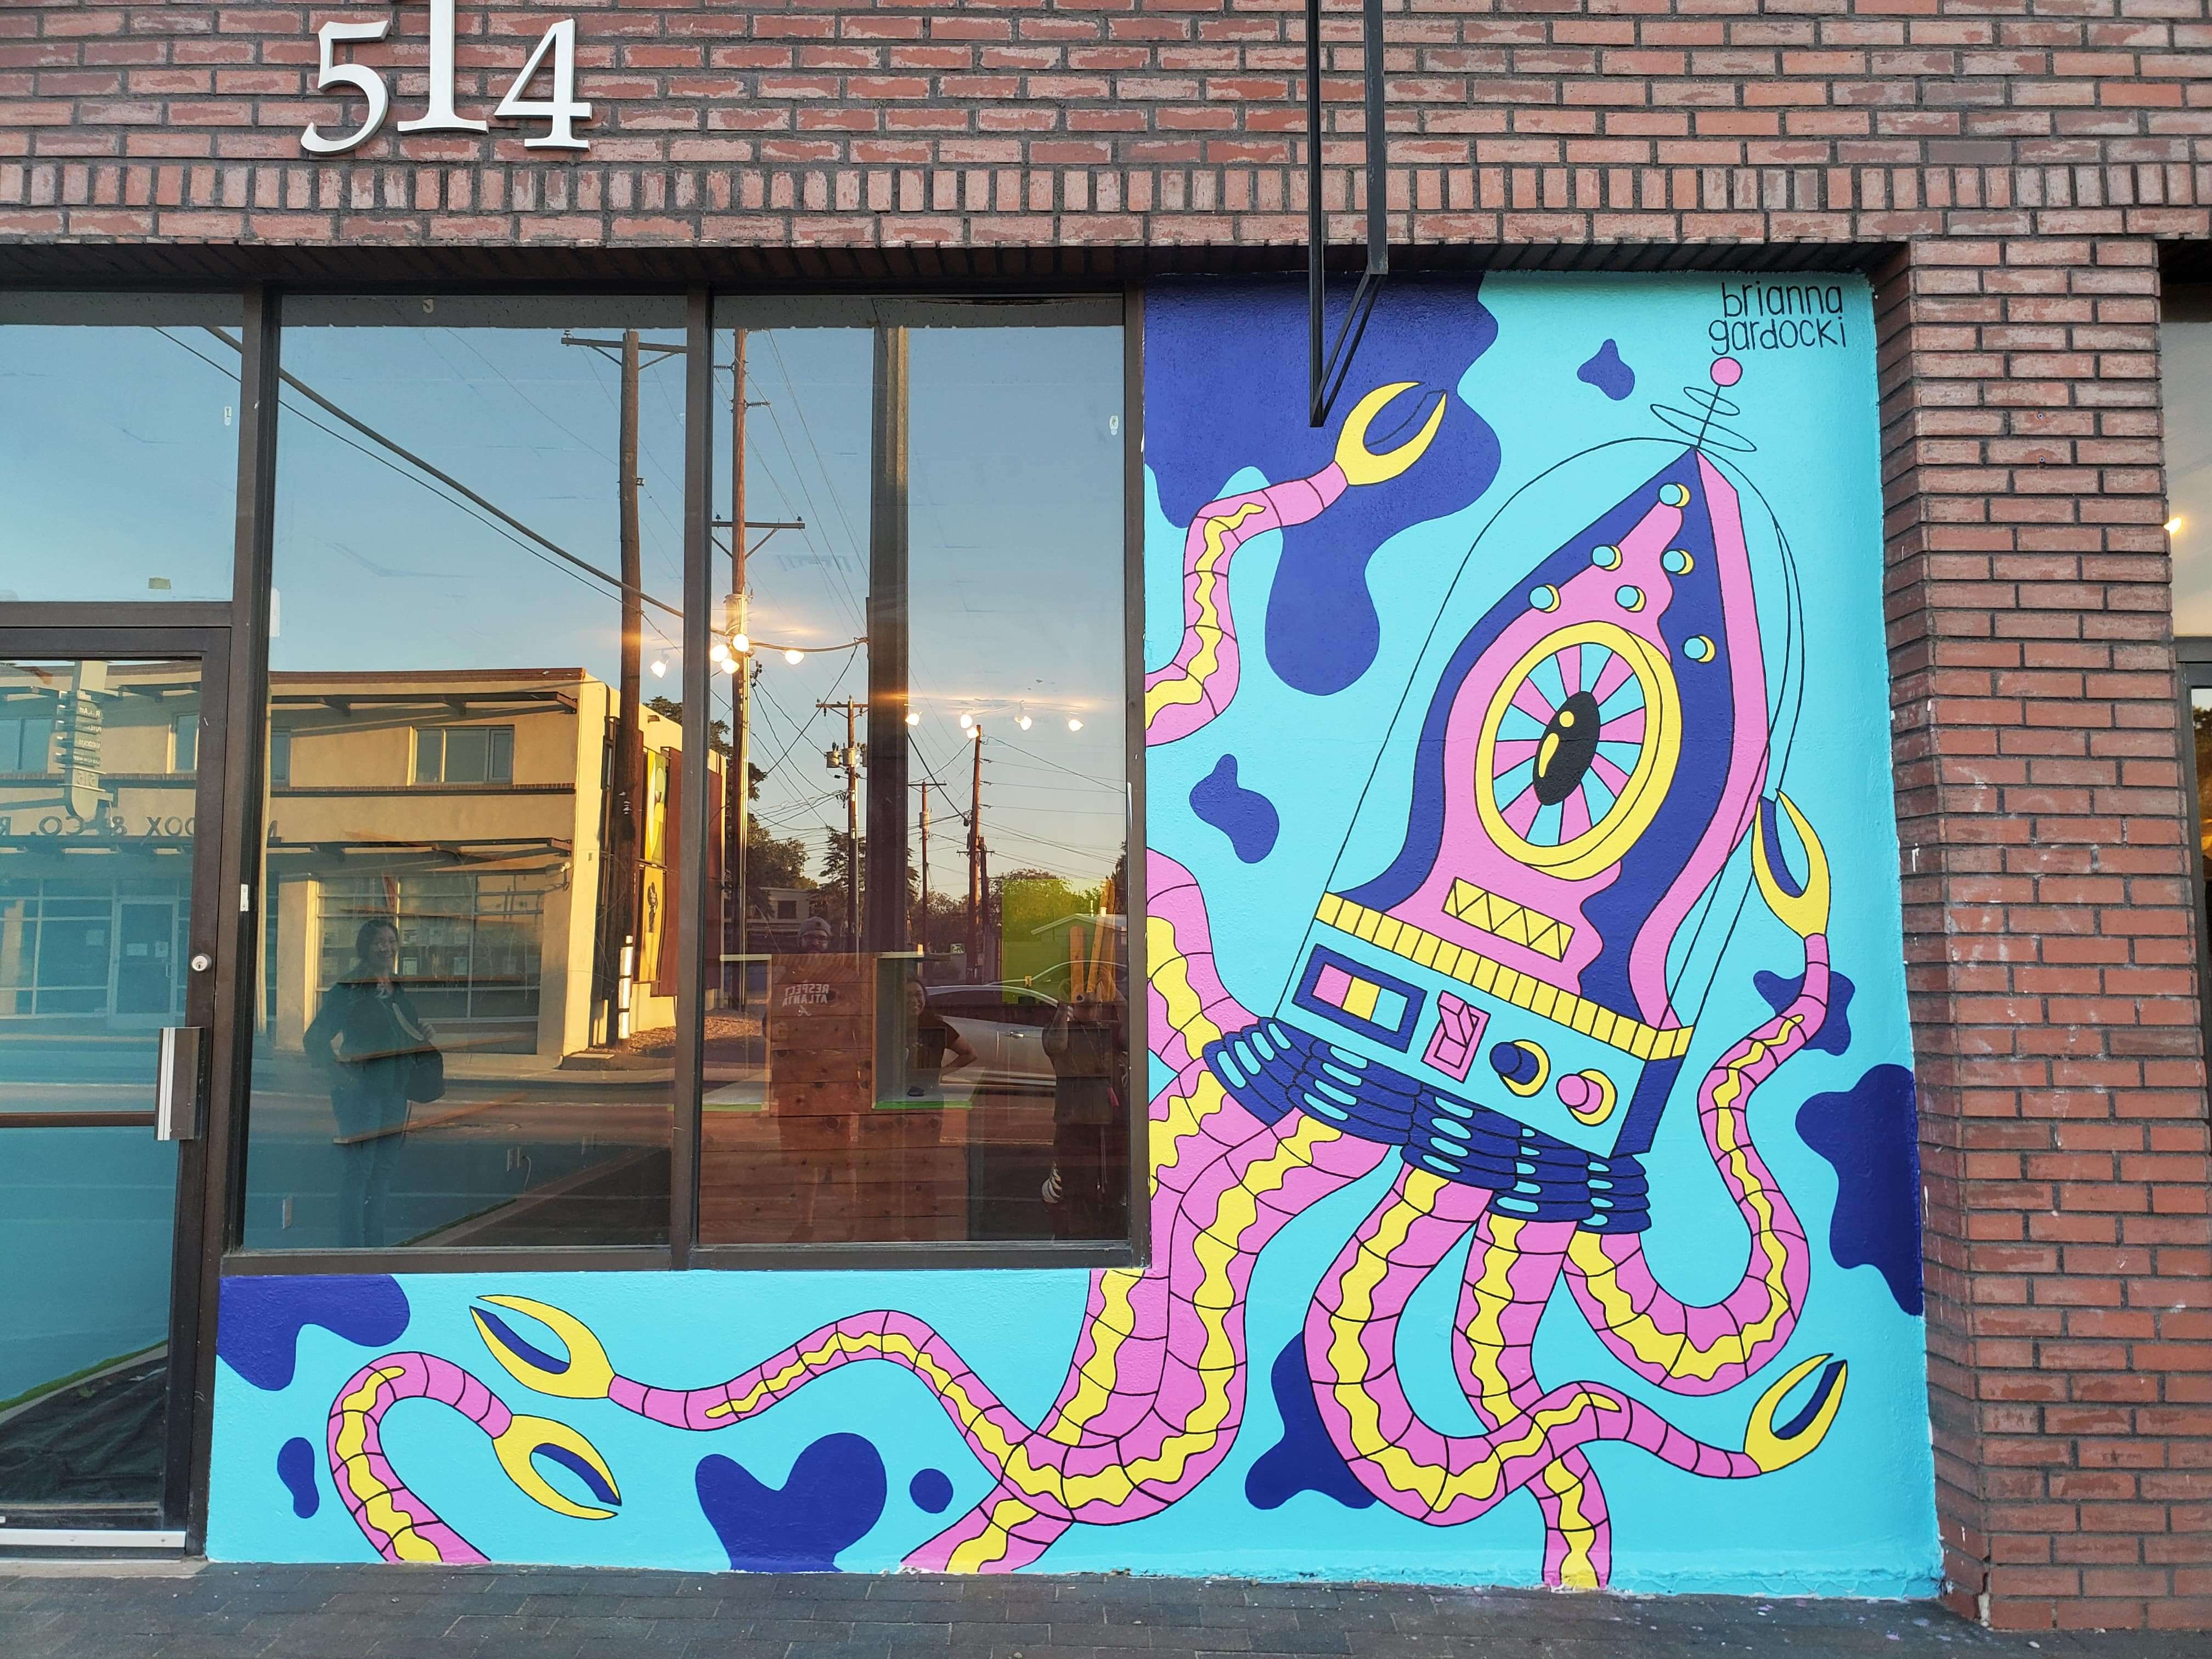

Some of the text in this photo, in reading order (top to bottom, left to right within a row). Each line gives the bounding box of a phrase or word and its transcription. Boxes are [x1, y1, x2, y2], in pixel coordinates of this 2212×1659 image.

[300, 0, 592, 156] 514
[1720, 280, 1844, 318] brianna
[1708, 315, 1847, 356] gardocki
